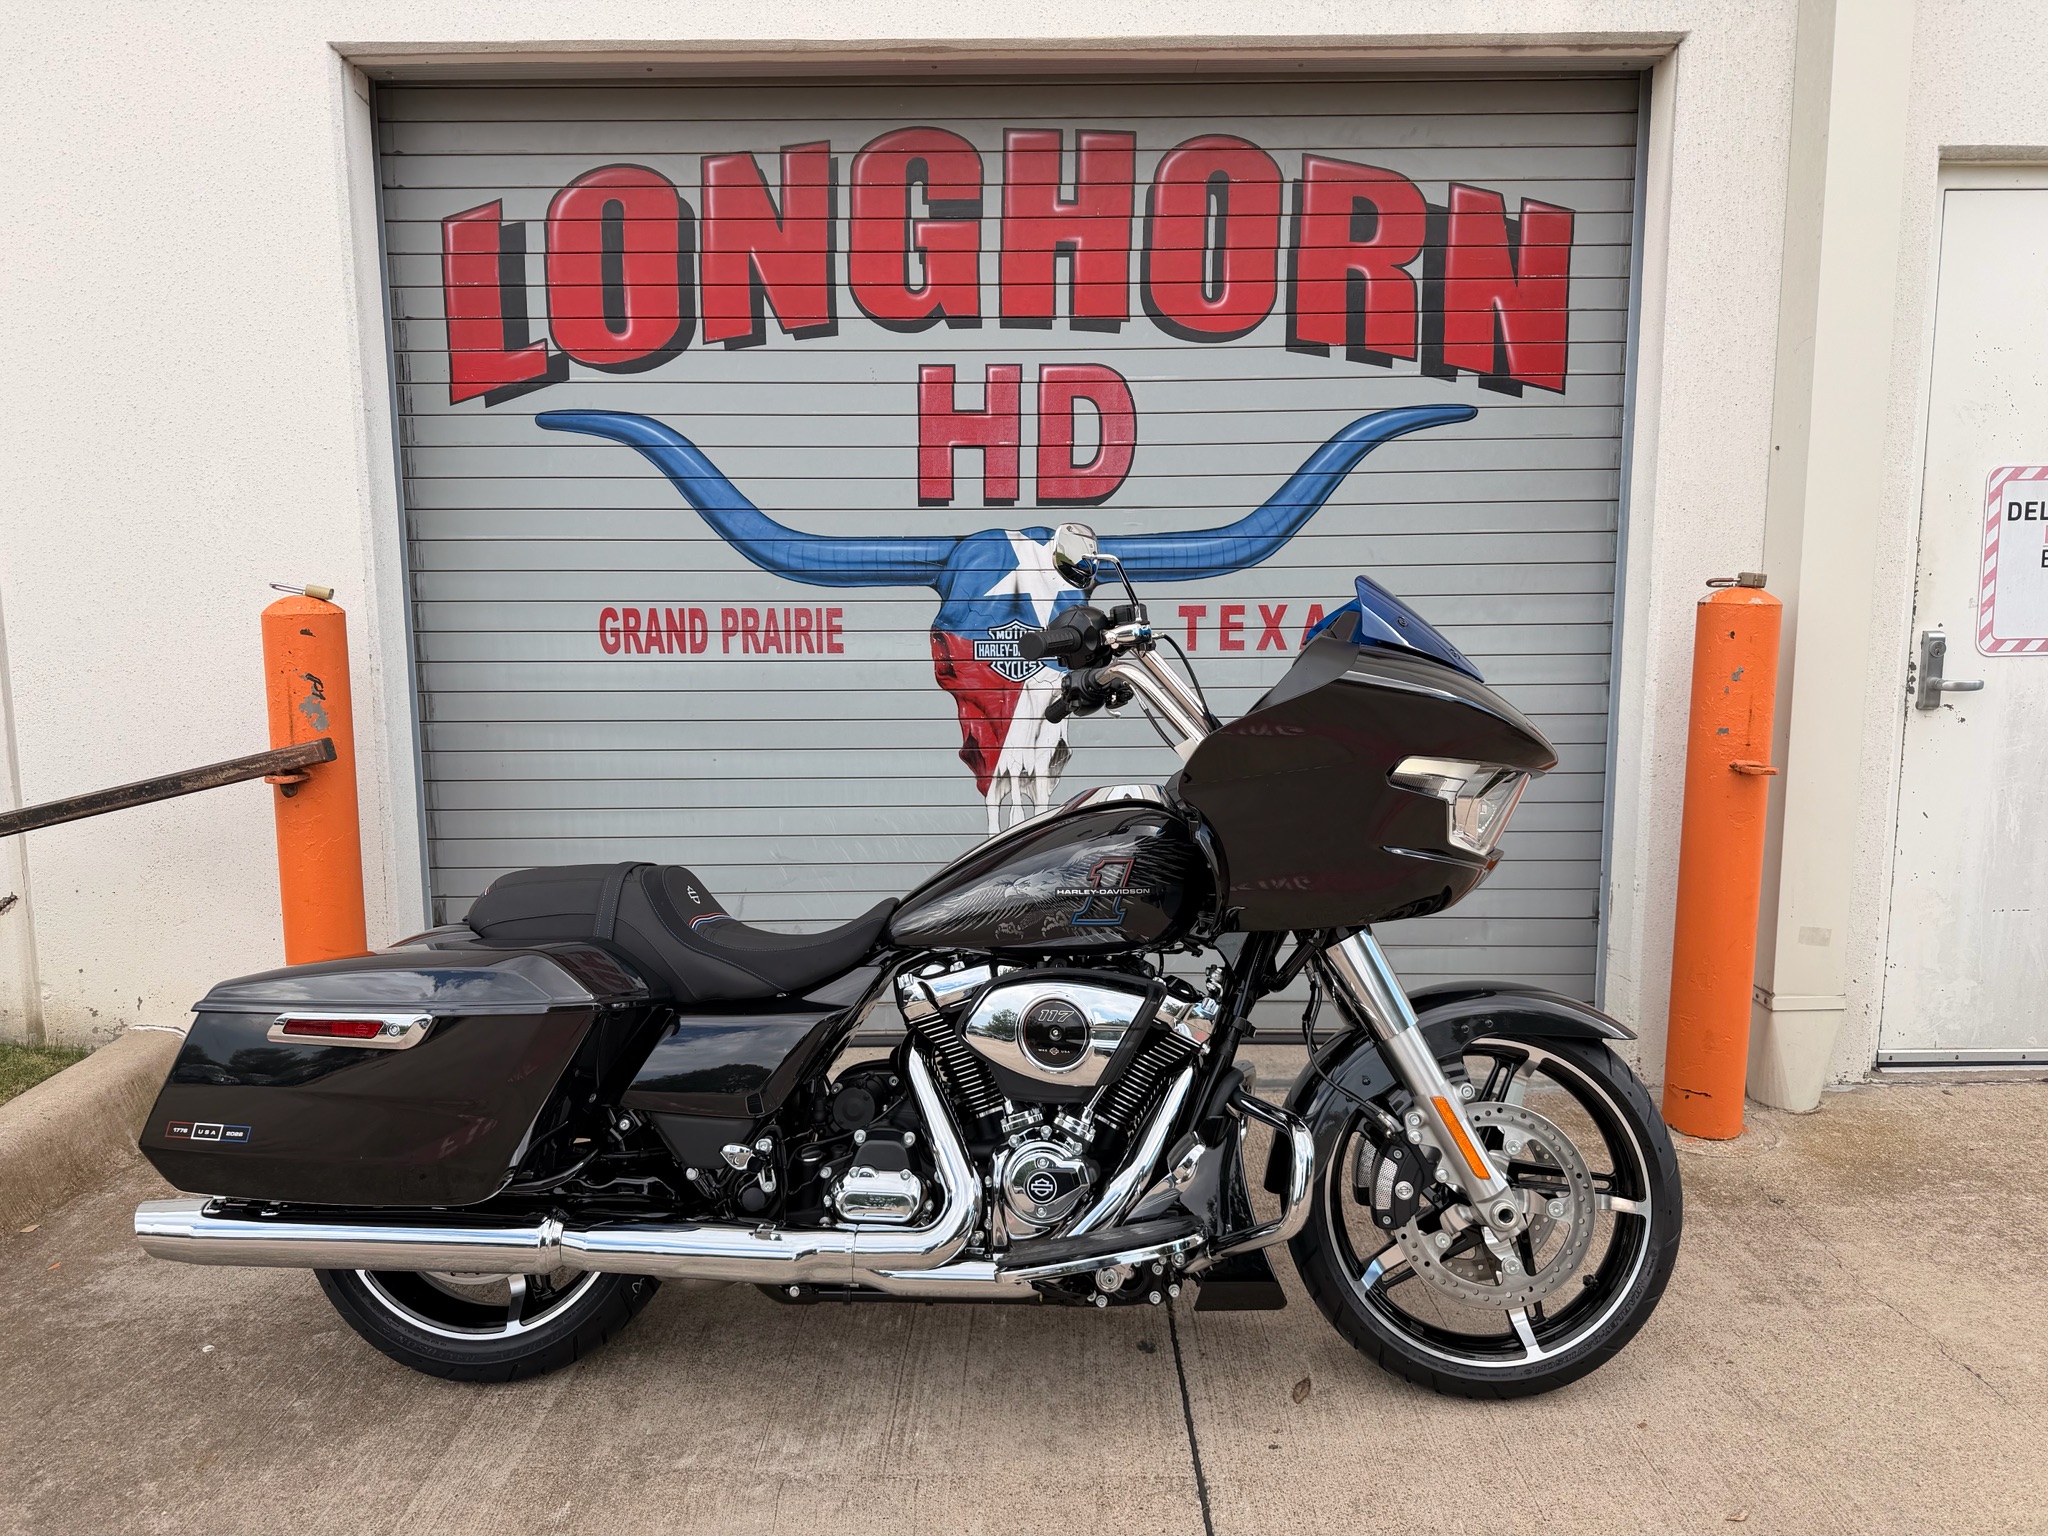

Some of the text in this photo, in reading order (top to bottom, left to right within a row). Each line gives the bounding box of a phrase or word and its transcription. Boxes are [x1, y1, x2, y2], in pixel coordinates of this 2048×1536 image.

[441, 126, 1575, 408] LONGHORN
[917, 363, 1137, 506] HD
[600, 607, 844, 655] GRAND PRAIRIE
[1178, 604, 1325, 651] TEXA
[997, 661, 1037, 679] CYCLES
[1038, 1009, 1075, 1023] 117
